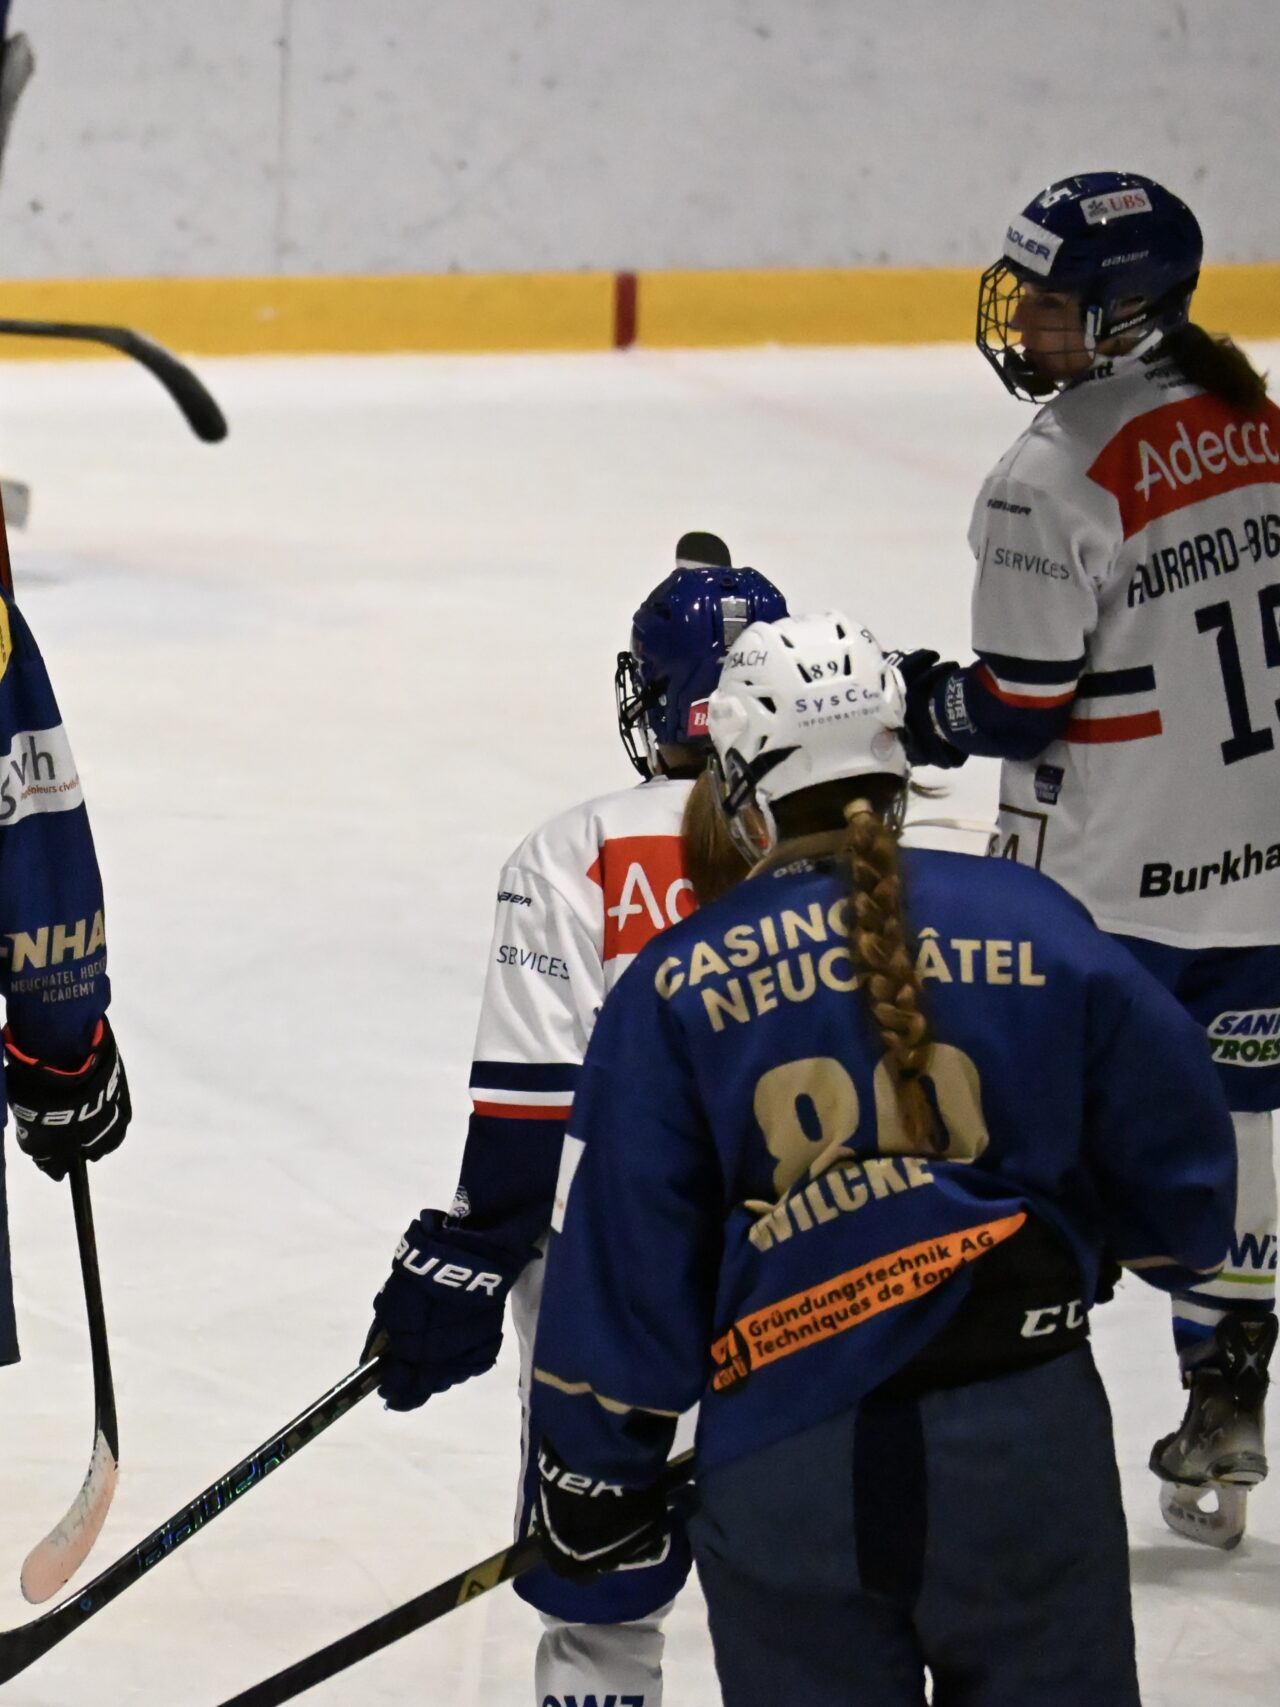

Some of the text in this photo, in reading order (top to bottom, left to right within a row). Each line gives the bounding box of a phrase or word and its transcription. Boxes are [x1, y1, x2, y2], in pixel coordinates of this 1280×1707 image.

[1108, 193, 1148, 211] UBS
[994, 547, 1070, 580] SERVICES
[810, 661, 838, 679] 89
[4, 908, 106, 974] NHA
[42, 981, 96, 1003] ACADEMY
[701, 927, 1047, 1033] NEUCÂTEL
[748, 1231, 995, 1338] Gründungstechnik AG
[753, 1299, 872, 1359] Techniques
[877, 1283, 905, 1303] de
